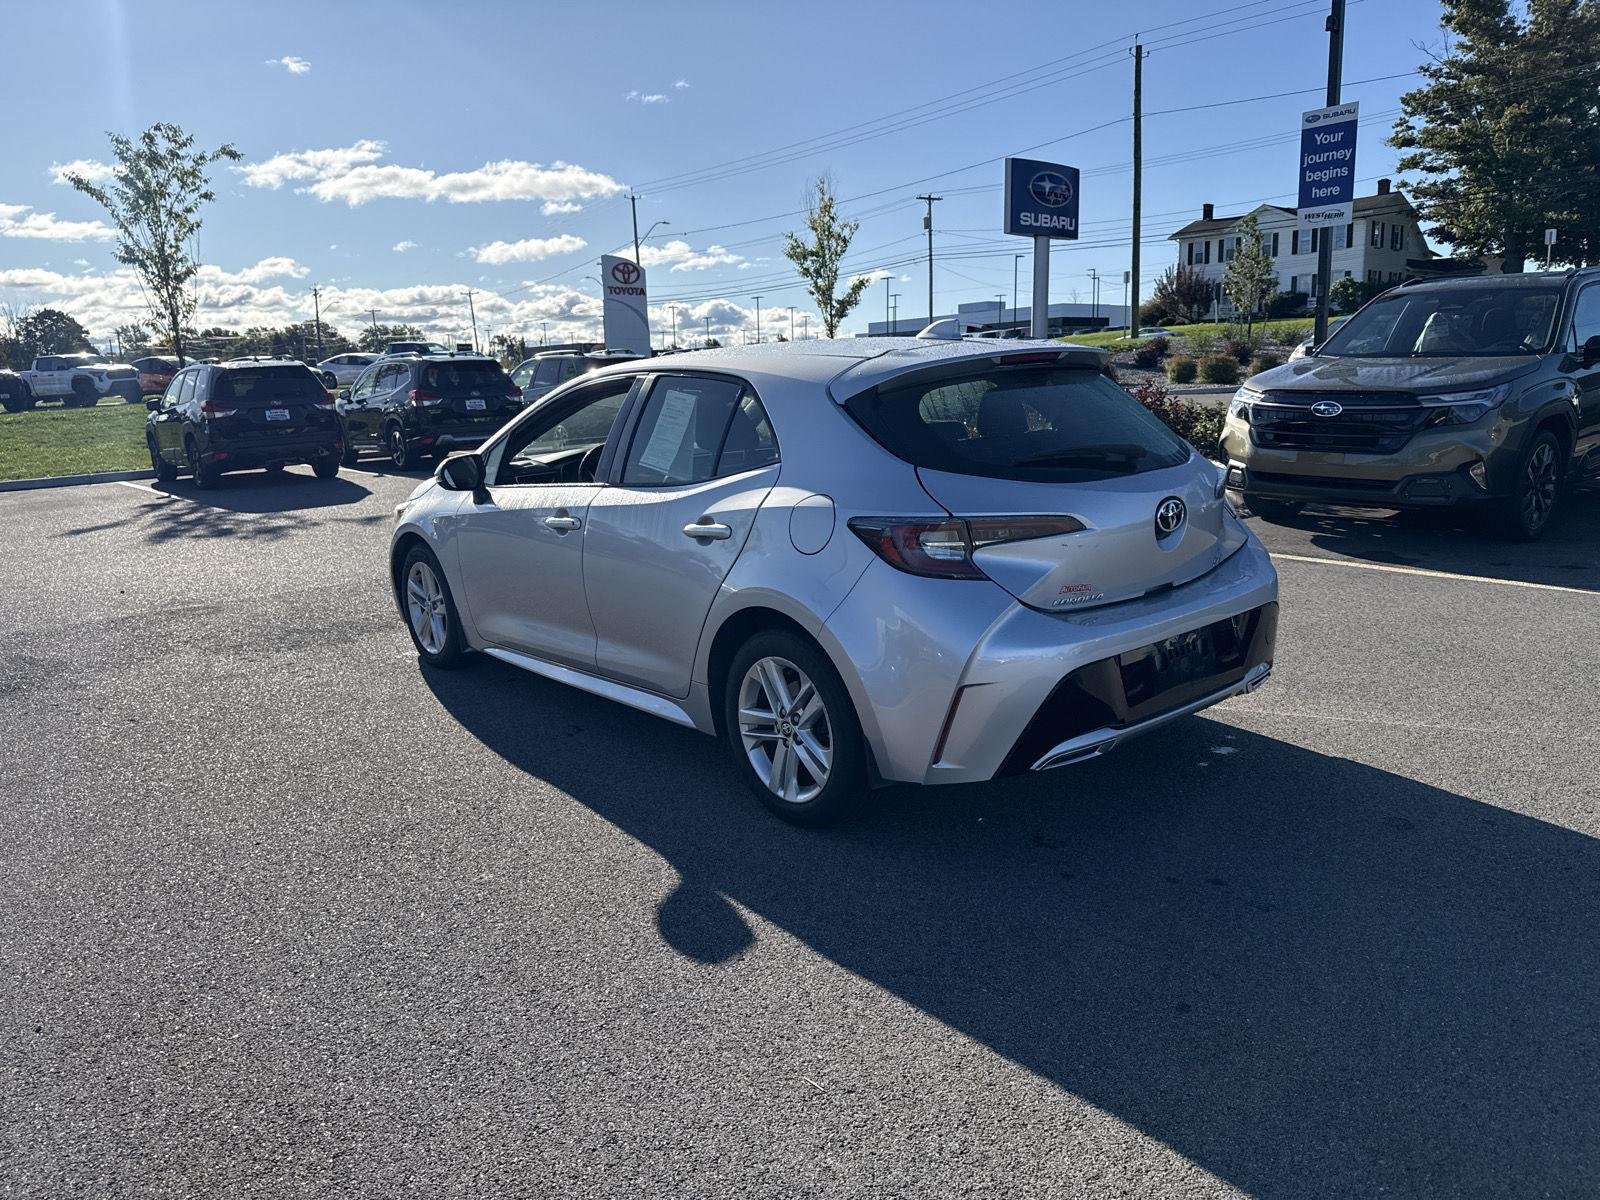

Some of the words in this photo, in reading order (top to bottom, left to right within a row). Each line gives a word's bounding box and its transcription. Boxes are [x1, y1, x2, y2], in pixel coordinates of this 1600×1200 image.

[1322, 108, 1356, 120] SUBARU
[1314, 131, 1345, 145] Your
[1303, 148, 1353, 167] journey
[1305, 166, 1349, 182] begins
[1311, 185, 1341, 199] here
[1019, 212, 1075, 231] SUBARU
[607, 286, 646, 296] TOYOTA
